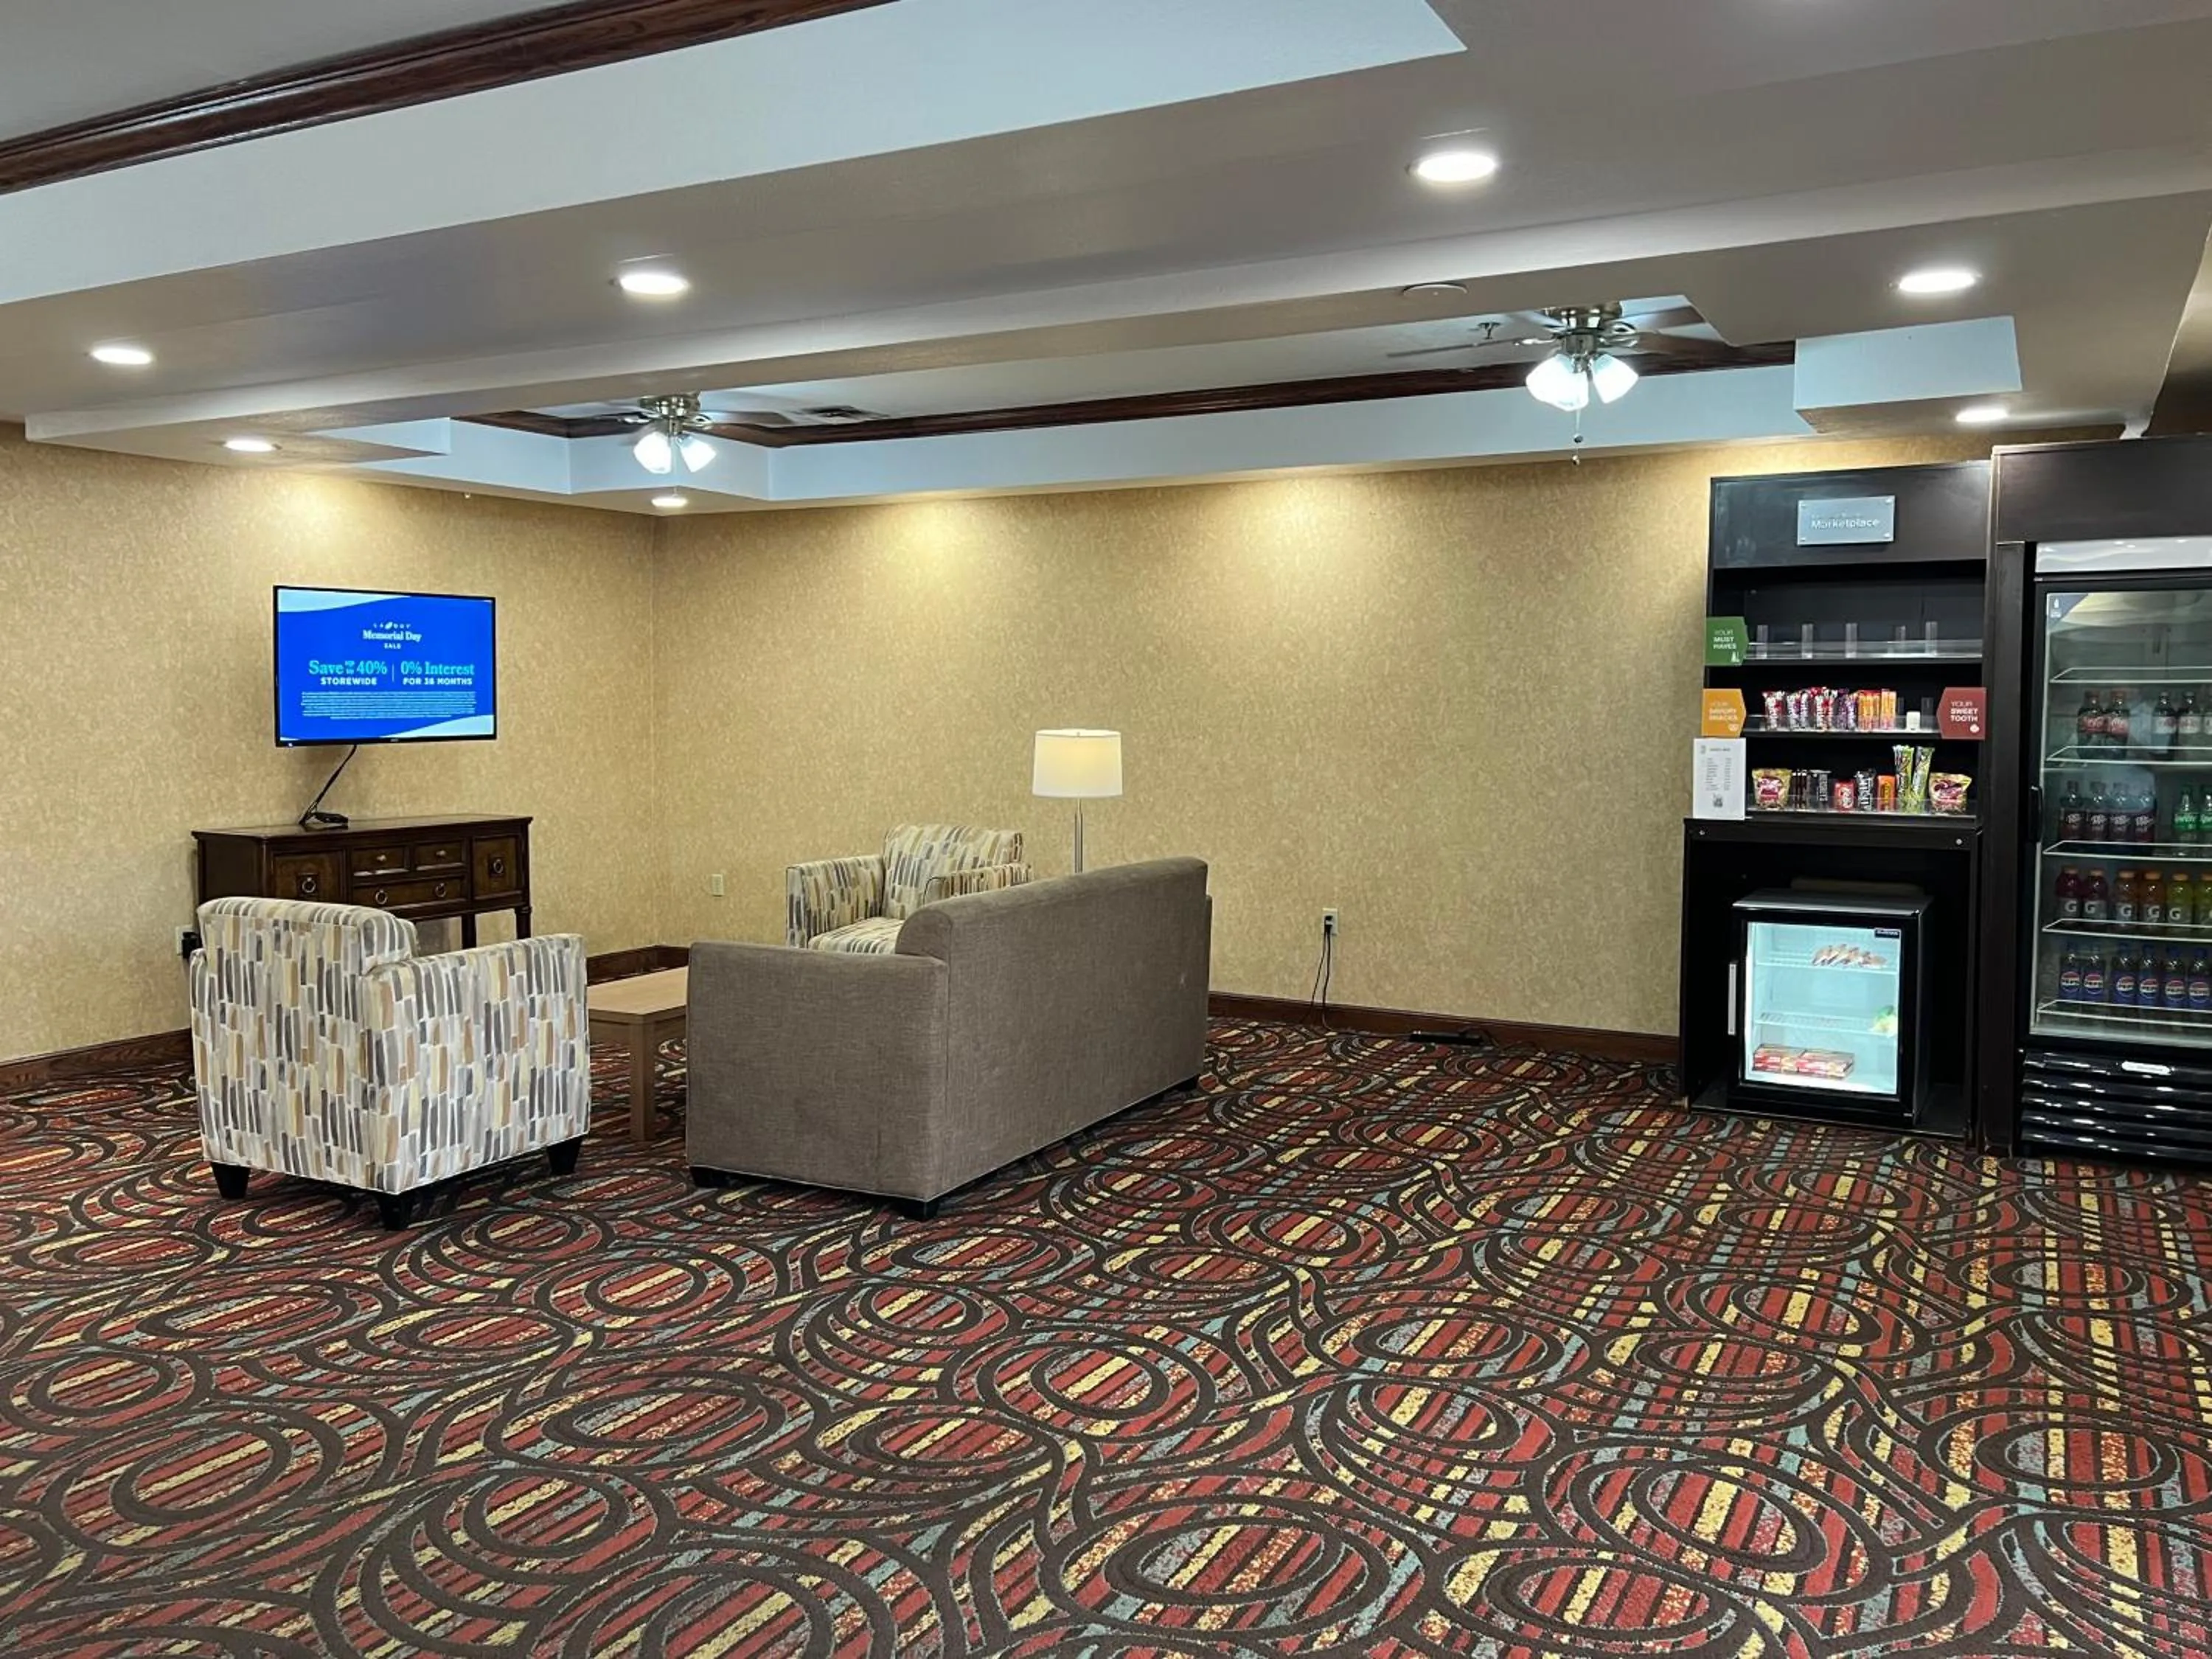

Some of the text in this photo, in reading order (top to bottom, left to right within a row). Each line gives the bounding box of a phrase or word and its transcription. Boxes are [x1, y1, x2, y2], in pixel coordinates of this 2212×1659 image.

[1811, 518, 1879, 529] Marketplace
[363, 629, 422, 642] Memorial Day
[308, 660, 344, 675] Save
[356, 660, 388, 675] 40%
[400, 661, 475, 675] 0% Interest
[320, 677, 378, 685] STOREWIDE
[437, 678, 473, 686] MONTHS
[2065, 900, 2077, 912] G
[2084, 902, 2096, 914] G
[2121, 905, 2132, 917] G
[2149, 905, 2160, 917] G
[2169, 908, 2180, 919] G
